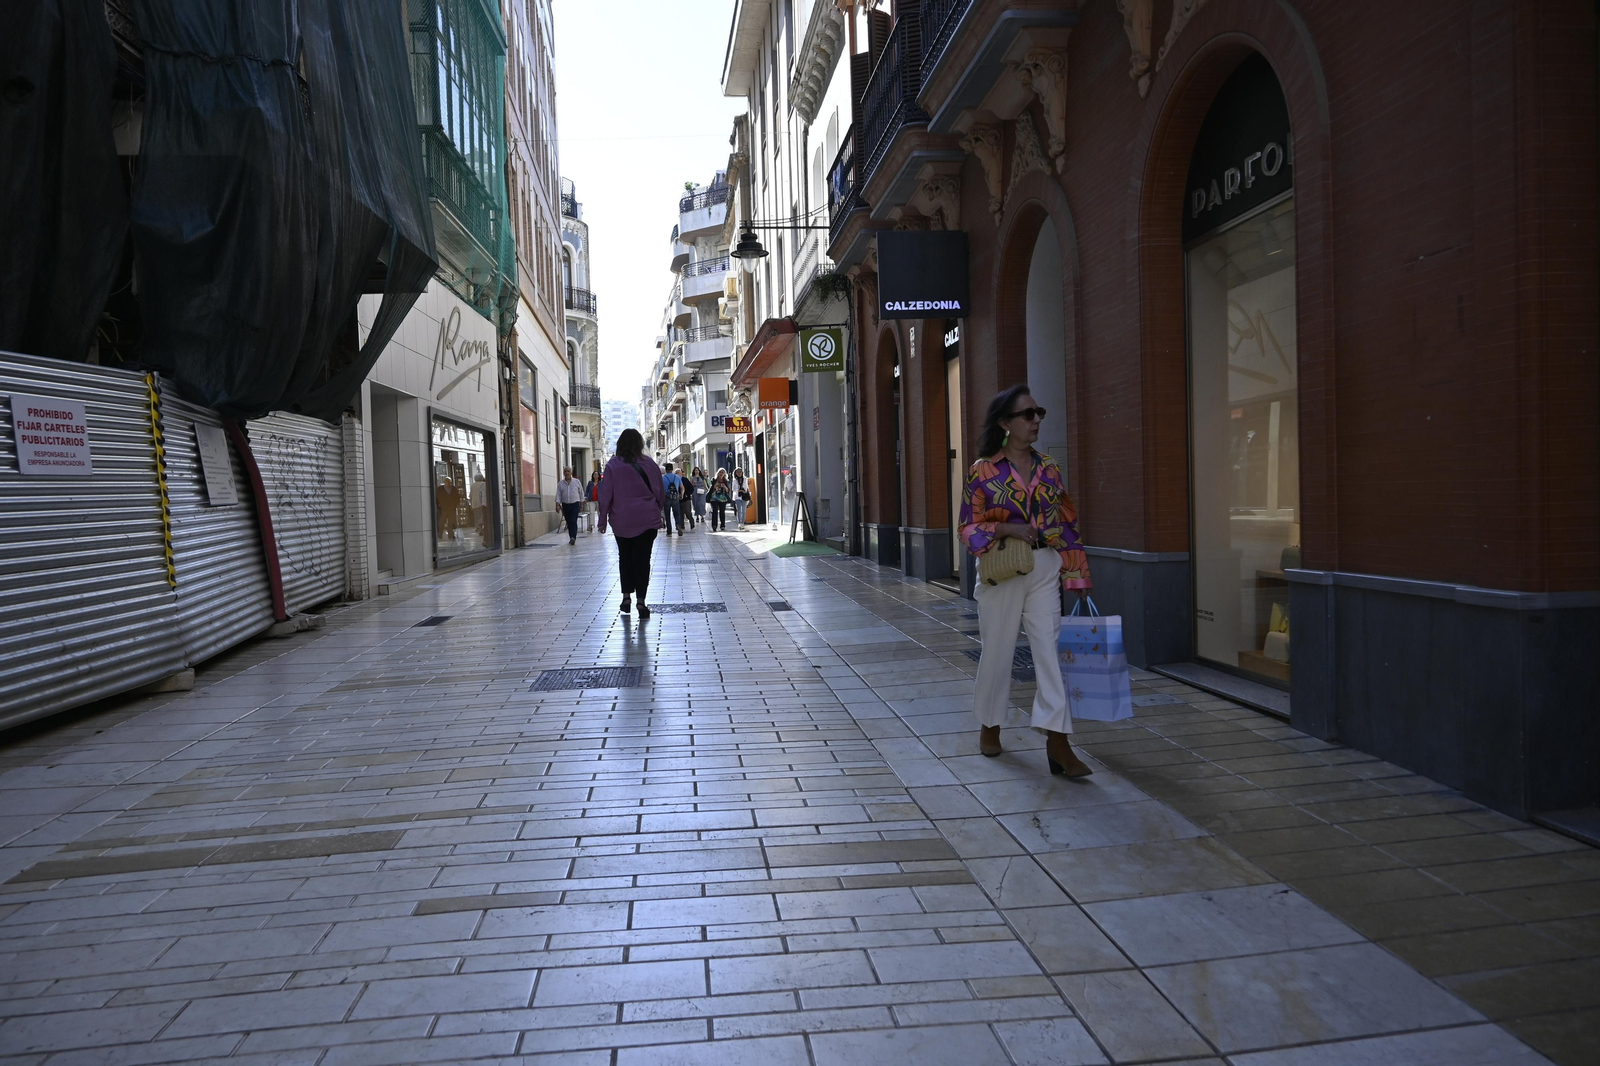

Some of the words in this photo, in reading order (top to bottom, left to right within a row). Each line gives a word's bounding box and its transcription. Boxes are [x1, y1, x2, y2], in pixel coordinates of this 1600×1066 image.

[885, 300, 961, 311] CALZEDONIA
[27, 407, 74, 420] PROHIBIDO
[17, 420, 42, 431] FIJAR
[44, 423, 85, 434] CARTELES
[22, 434, 85, 447] PUBLICITARIOS
[34, 450, 69, 458] RESPONSABLE
